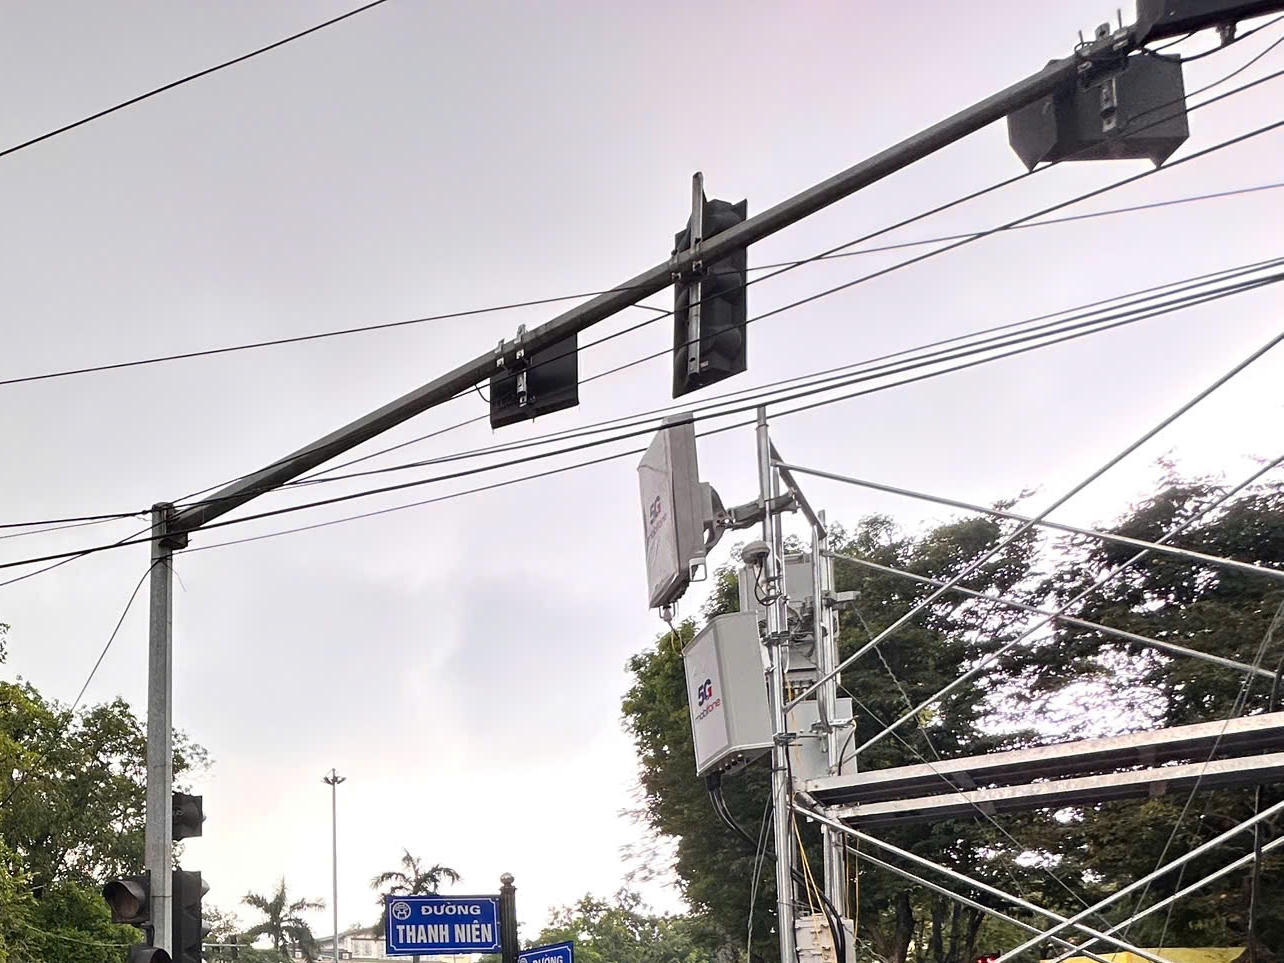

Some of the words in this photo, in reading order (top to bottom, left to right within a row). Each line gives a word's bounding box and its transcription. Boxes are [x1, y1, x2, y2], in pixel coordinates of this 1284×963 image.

[698, 679, 712, 706] 5G
[421, 902, 481, 916] ĐƯỜNG
[396, 924, 450, 944] THANH
[454, 919, 493, 943] NIÊN
